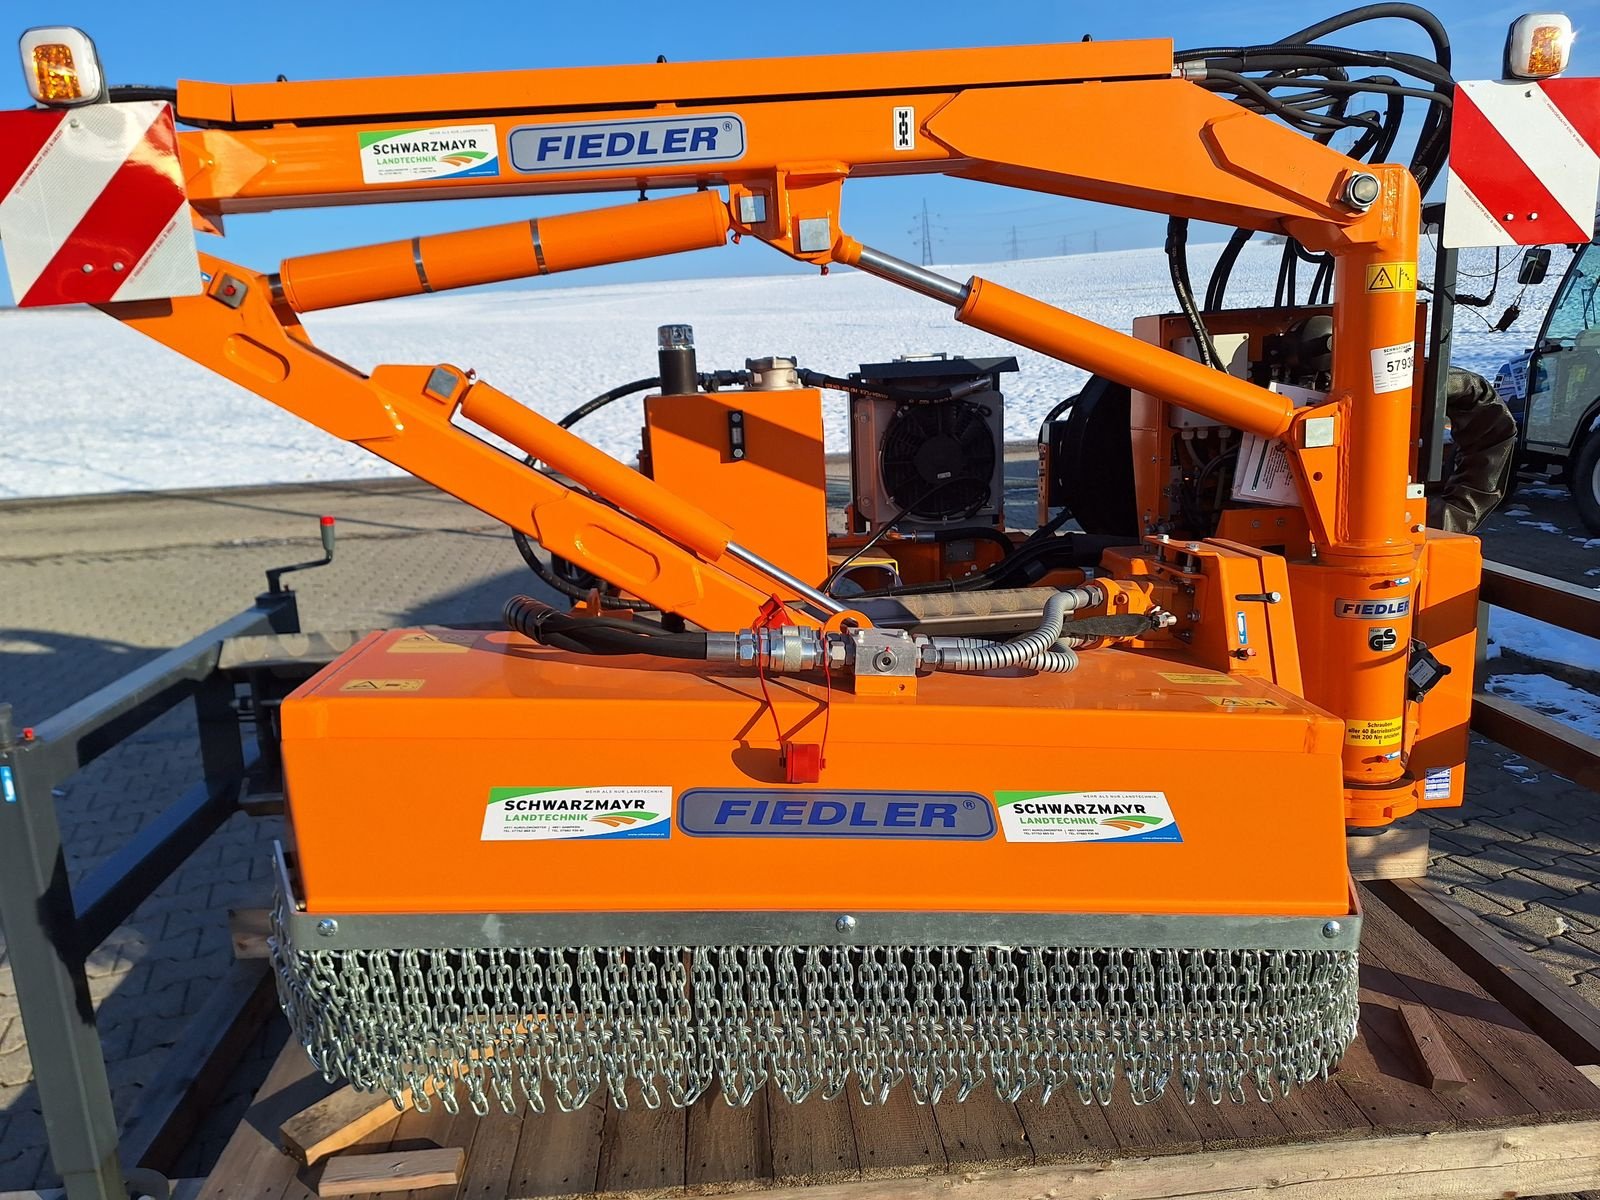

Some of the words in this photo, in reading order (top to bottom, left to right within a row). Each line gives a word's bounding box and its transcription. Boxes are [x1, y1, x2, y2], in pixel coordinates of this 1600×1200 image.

[373, 139, 477, 155] SCHWARZMAYR
[536, 126, 718, 162] FIEDLER
[376, 155, 438, 166] LANDTECHNIK
[1342, 600, 1409, 614] FIEDLER
[503, 800, 646, 811] SCHWARZMAYR
[1013, 803, 1146, 814] SCHWARZMAYR
[504, 813, 588, 822] LANDTECHNIK
[714, 800, 958, 828] FIEDLER
